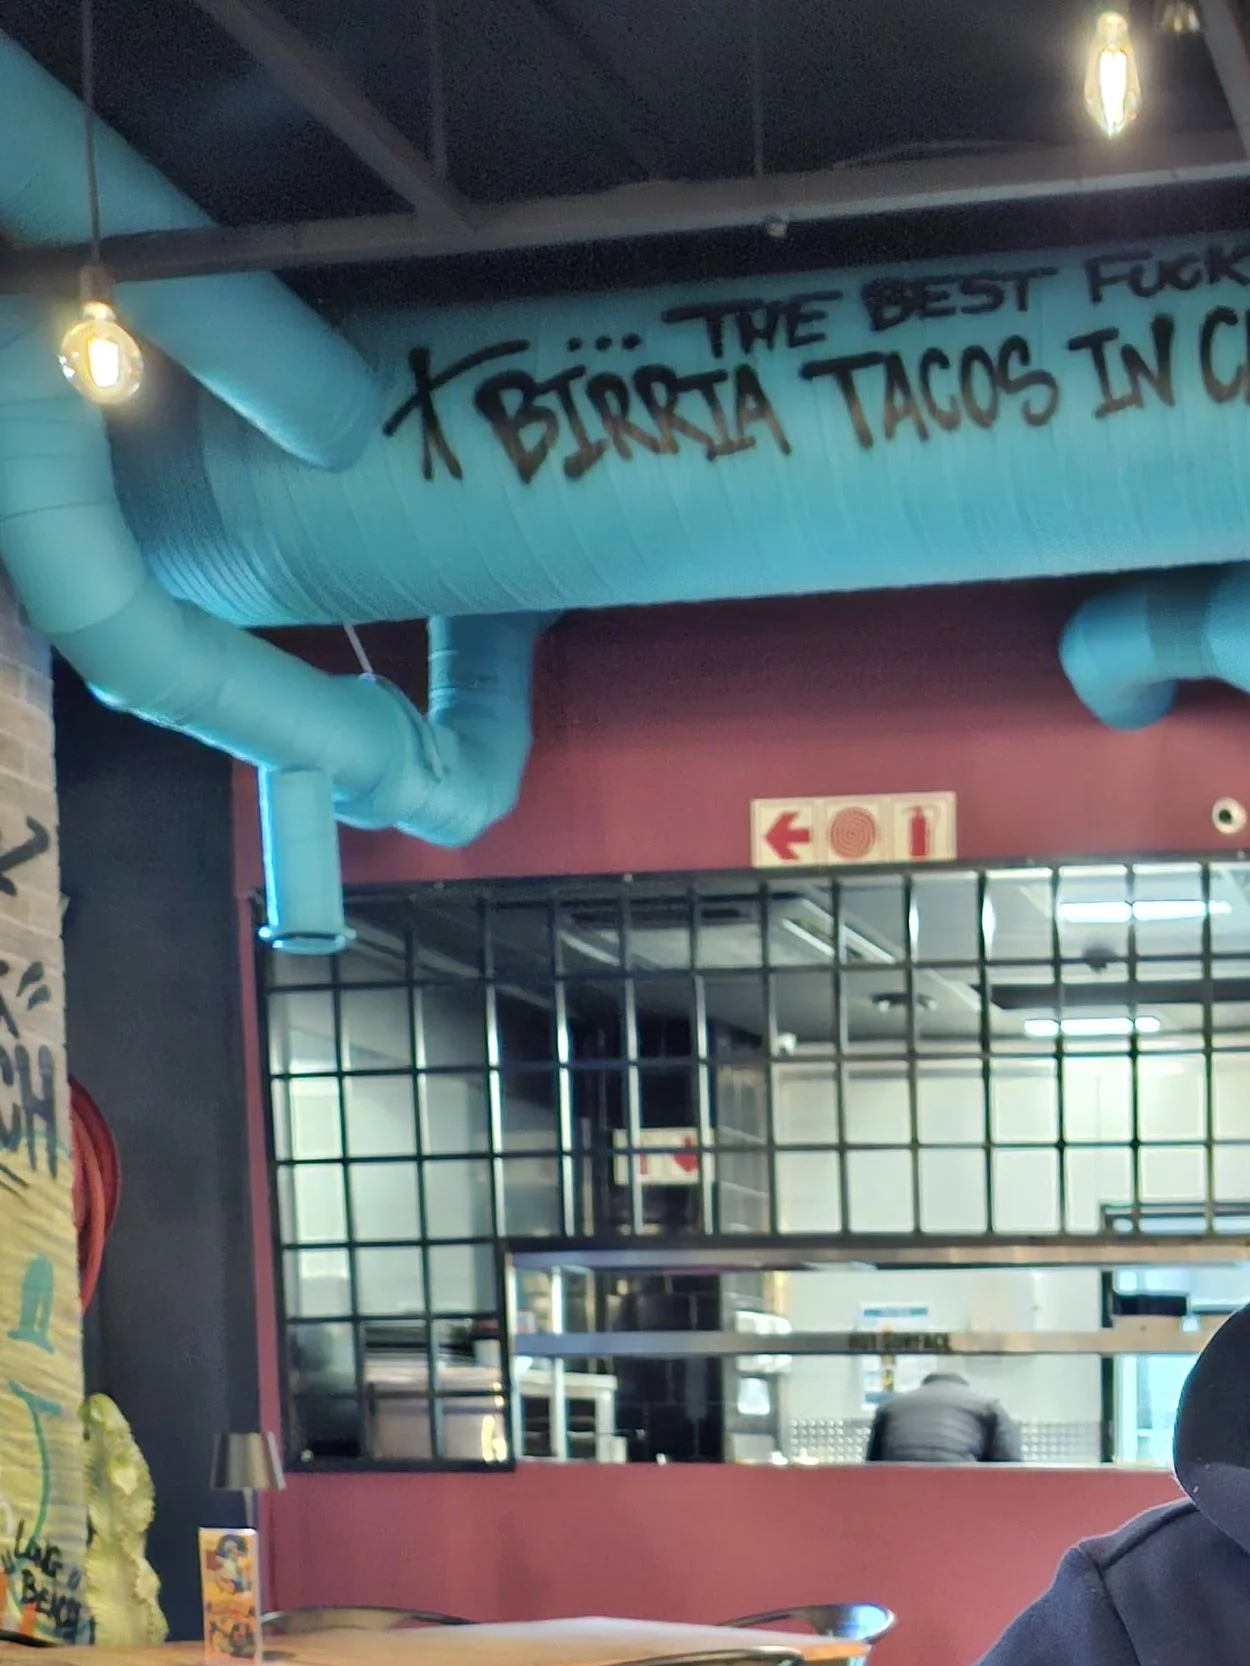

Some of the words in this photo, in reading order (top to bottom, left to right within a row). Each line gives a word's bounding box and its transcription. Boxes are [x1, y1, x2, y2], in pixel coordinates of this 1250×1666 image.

[861, 266, 1058, 332] BEST
[472, 364, 792, 486] BIRRIA
[799, 335, 1060, 450] TACOS
[1067, 312, 1175, 420] IN
